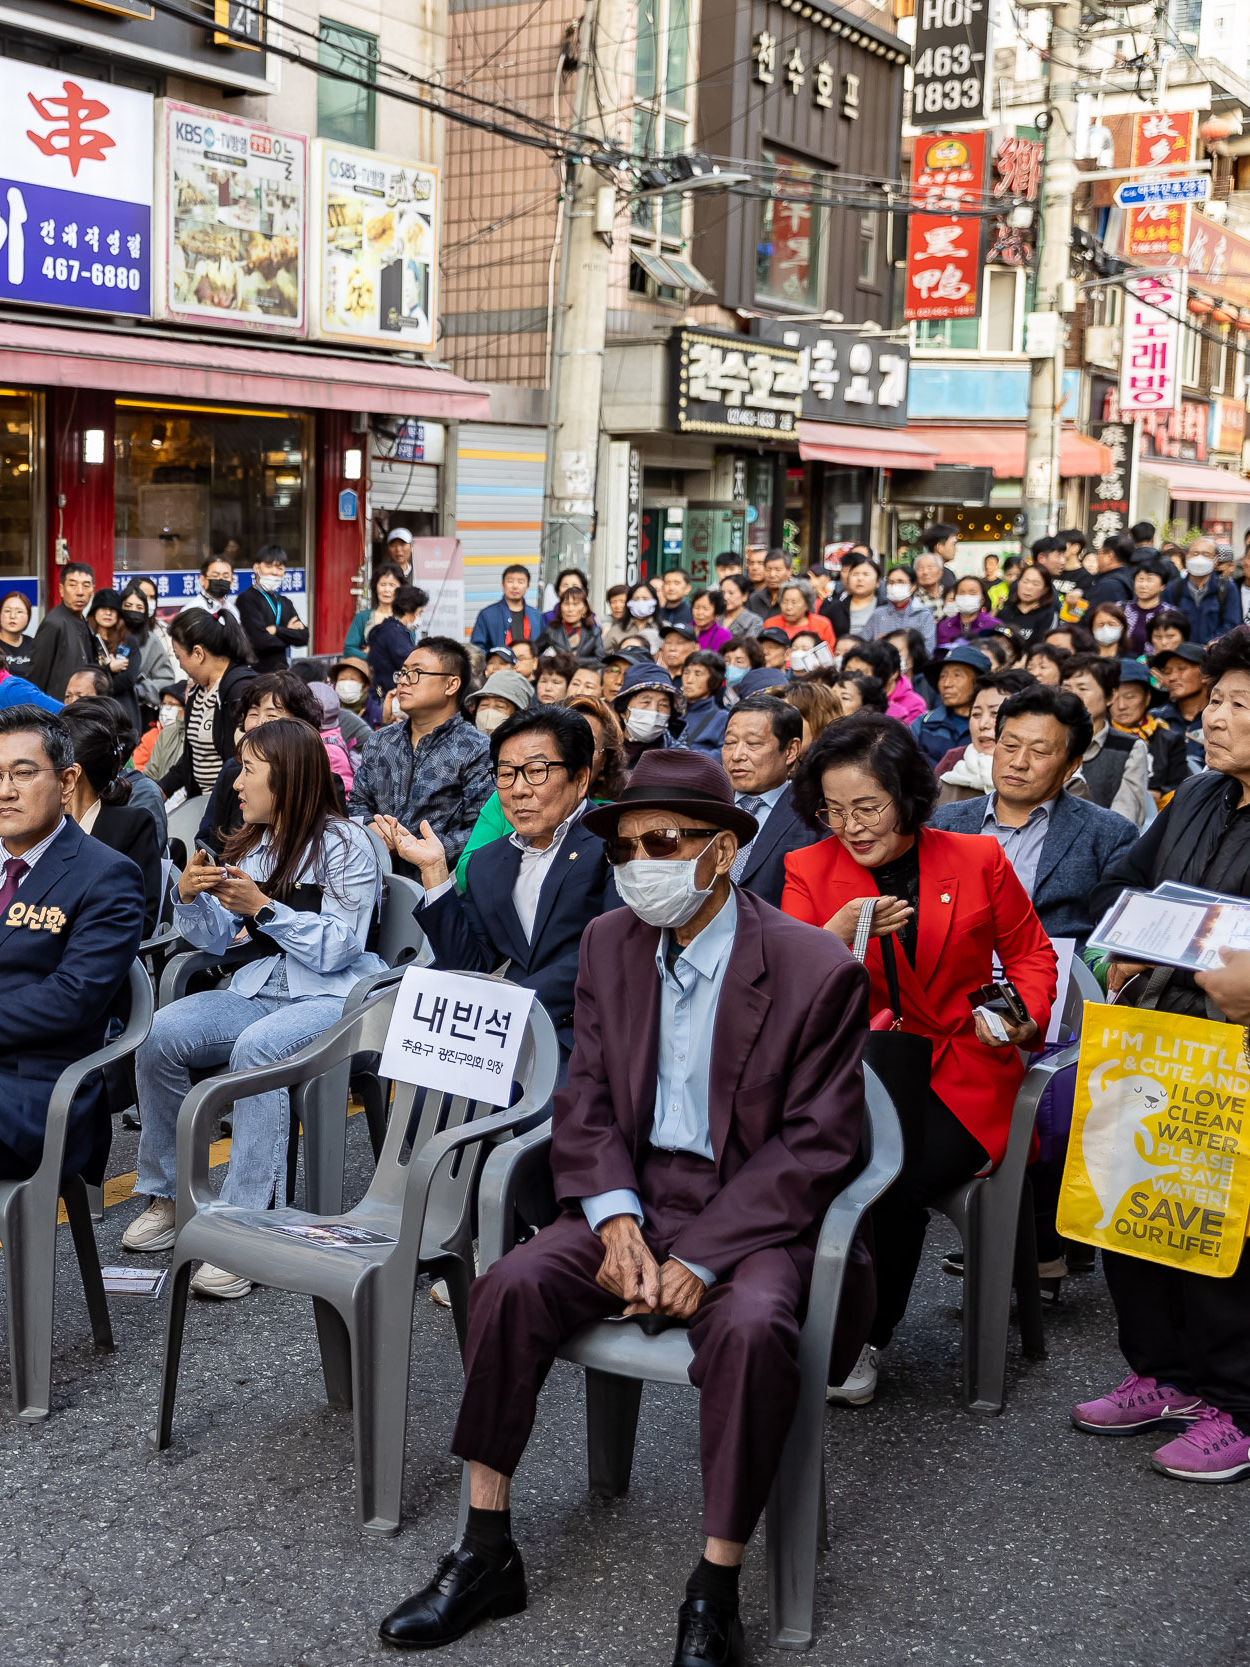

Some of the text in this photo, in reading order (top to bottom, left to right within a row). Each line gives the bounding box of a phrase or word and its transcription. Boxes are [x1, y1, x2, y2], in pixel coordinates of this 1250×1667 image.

[914, 43, 985, 78] 463-
[914, 77, 981, 114] 1833
[176, 121, 202, 144] KBS
[339, 162, 357, 180] SBS
[39, 219, 142, 258] 건대직영점
[41, 256, 141, 292] 467-6880
[5, 901, 67, 933] 오신환
[412, 992, 512, 1049] 내빈석
[402, 1038, 504, 1075] 추윤구 광진구의회 의장
[1101, 1027, 1250, 1075] I'M LITTLE
[1123, 1055, 1250, 1095] & CUTE. AND
[1170, 1083, 1247, 1115] I LOVE
[1167, 1104, 1243, 1135] CLEAN
[1157, 1121, 1241, 1155] WATER.
[1157, 1142, 1235, 1172] PLEASE
[1151, 1176, 1229, 1209] WATER!
[1179, 1166, 1232, 1190] SAVE
[1127, 1191, 1226, 1238] SAVE
[1115, 1218, 1222, 1258] OUR LIFE!
